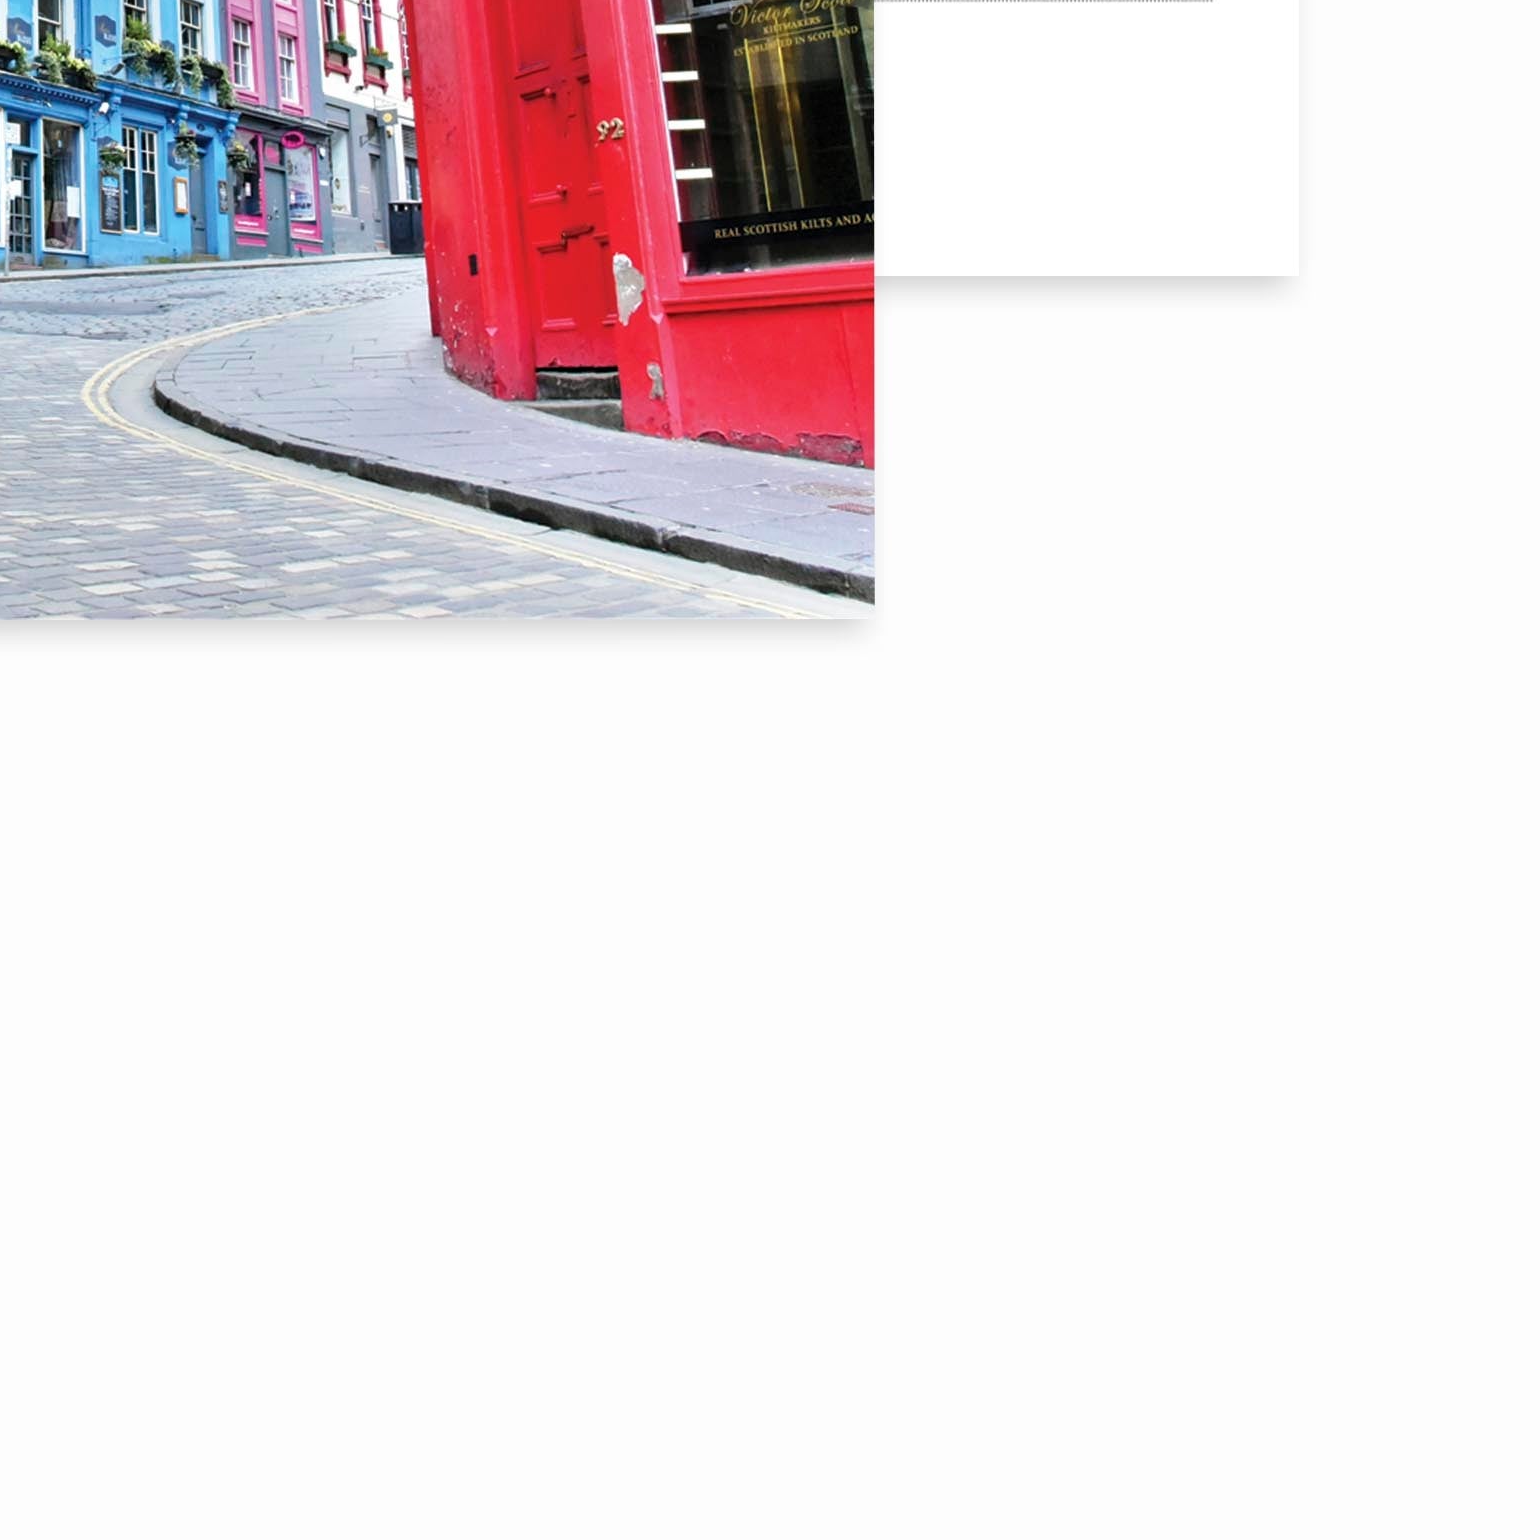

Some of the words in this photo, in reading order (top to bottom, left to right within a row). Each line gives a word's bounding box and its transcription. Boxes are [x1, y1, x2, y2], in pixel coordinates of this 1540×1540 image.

[763, 16, 822, 34] KILTMAKERS
[807, 25, 859, 43] SCOTLAND
[595, 117, 625, 141] 92
[714, 229, 742, 239] REAL
[743, 220, 798, 235] SCOTTISH
[800, 216, 833, 230] KILTS
[835, 213, 862, 227] AND
